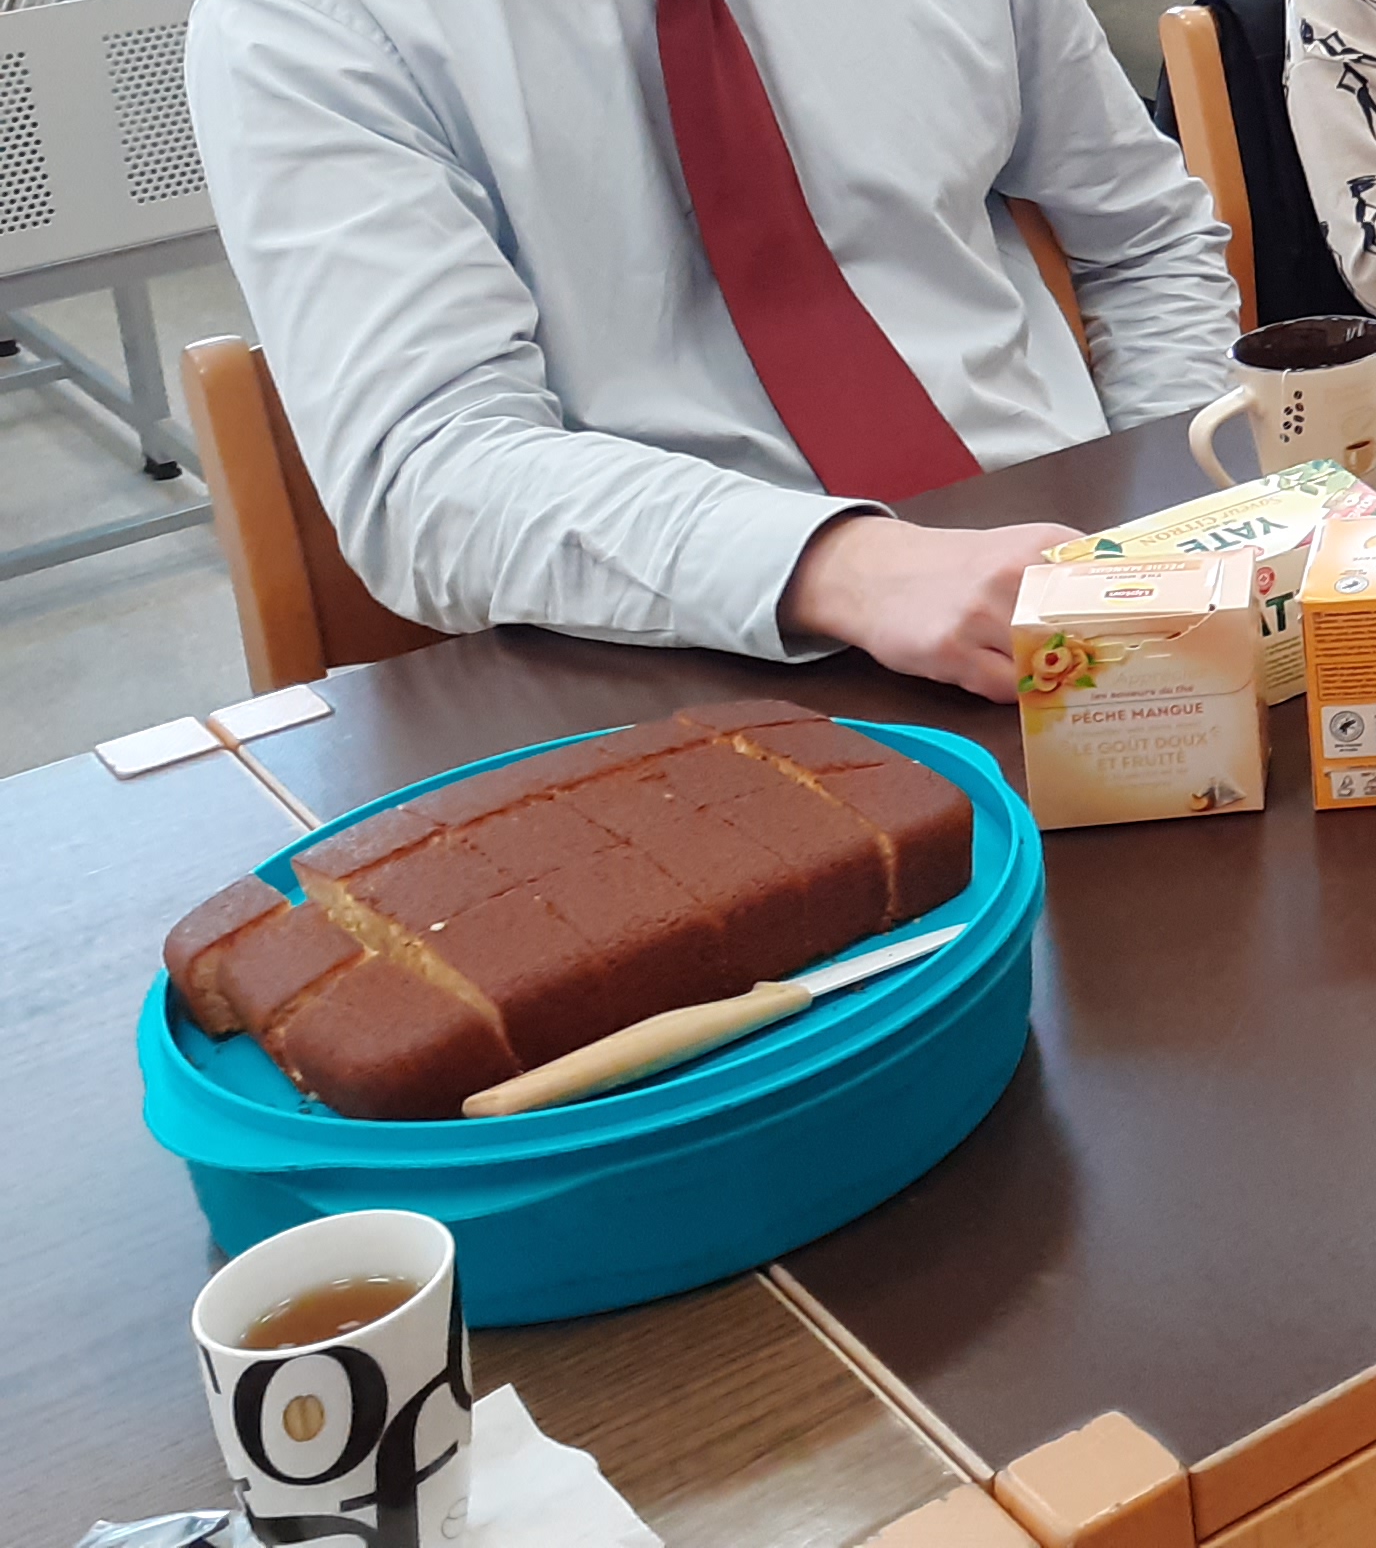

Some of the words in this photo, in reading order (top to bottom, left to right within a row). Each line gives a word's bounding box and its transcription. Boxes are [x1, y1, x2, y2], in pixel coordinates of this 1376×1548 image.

[1218, 493, 1284, 523] Saveur
[1139, 514, 1219, 548] CITRON
[1107, 588, 1152, 599] Lipton
[1158, 685, 1174, 696] du
[1131, 701, 1205, 721] MANGUE
[1074, 740, 1095, 757] LE
[1096, 731, 1150, 755] GOÛT
[1154, 732, 1209, 750] DOUX
[1098, 755, 1118, 770] ET
[1121, 748, 1187, 769] FRUITÉ
